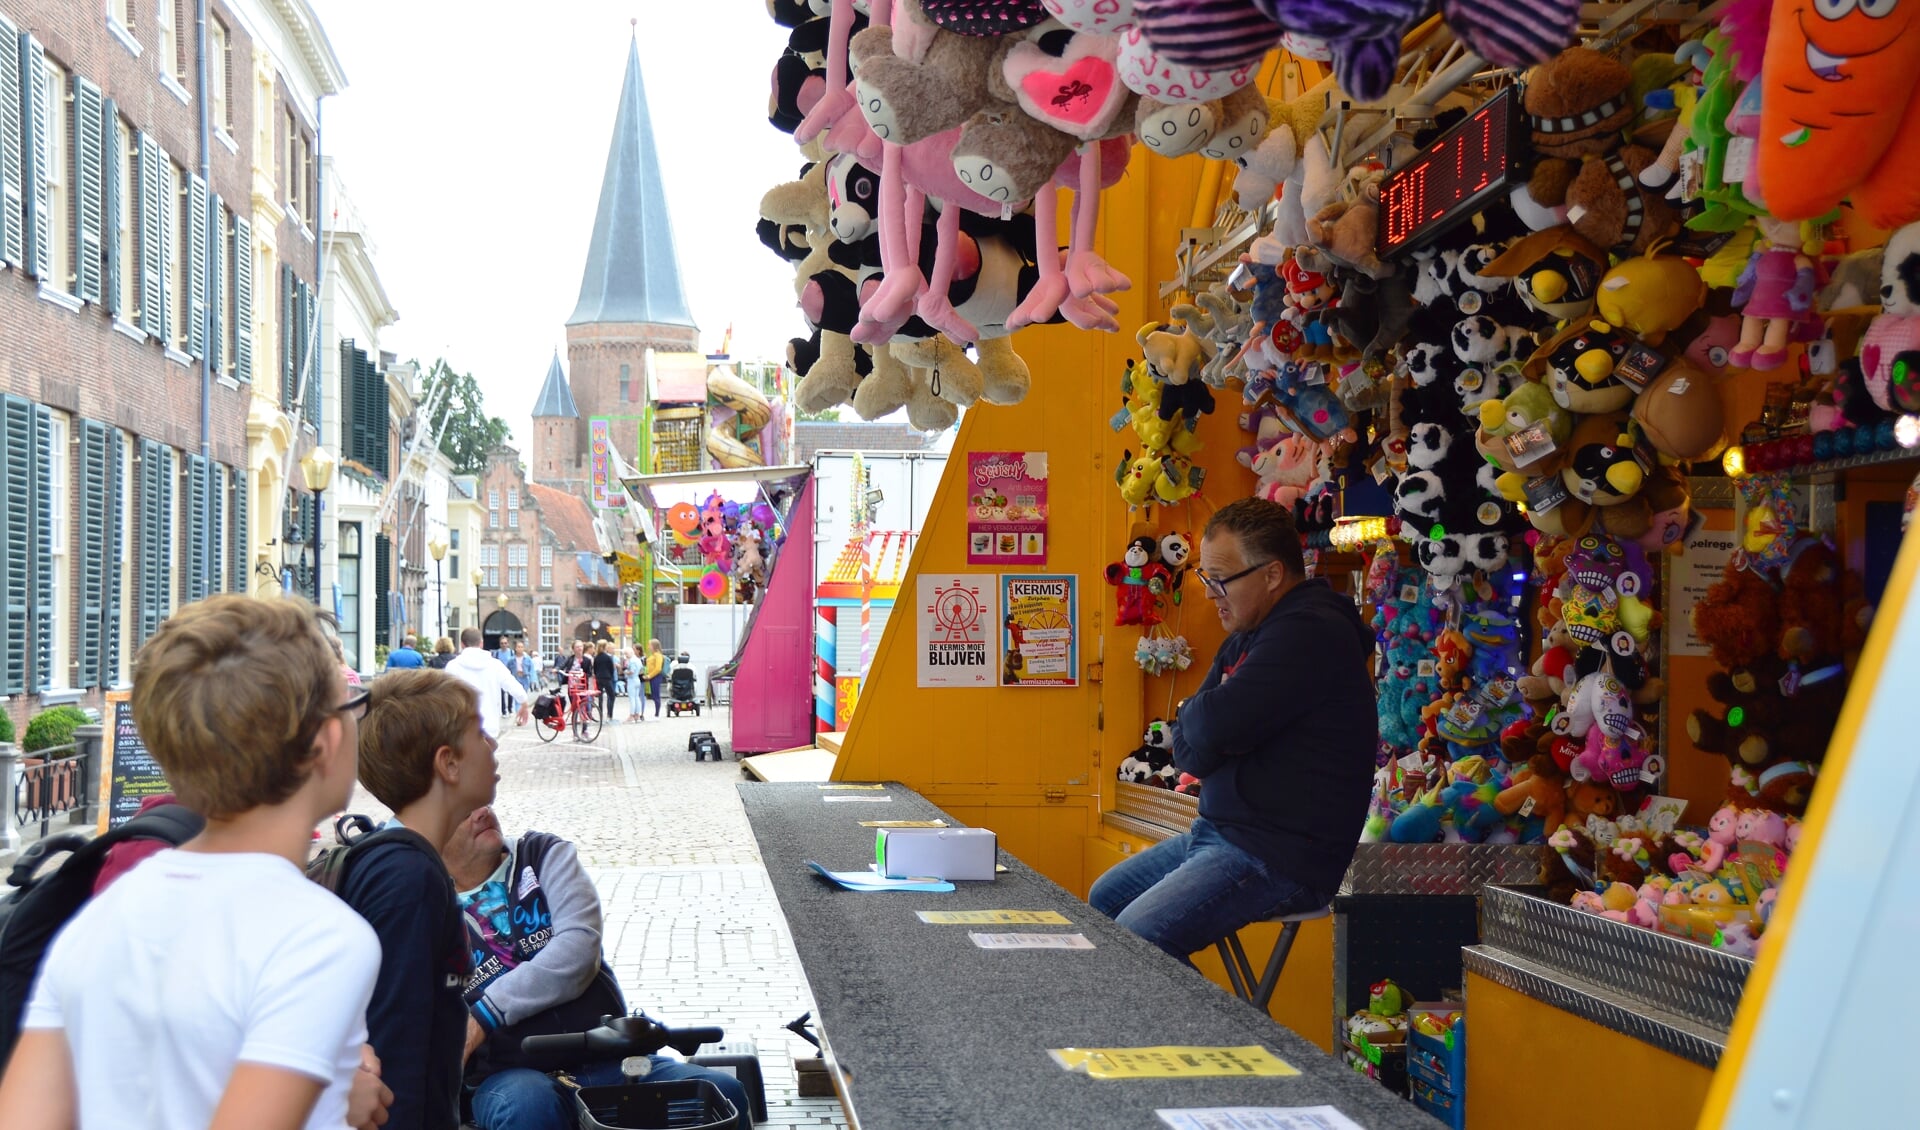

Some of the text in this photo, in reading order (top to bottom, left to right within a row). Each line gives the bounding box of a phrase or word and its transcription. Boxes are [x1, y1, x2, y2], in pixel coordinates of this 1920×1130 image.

[592, 426, 607, 501] HOTEL
[1014, 583, 1063, 595] KERMIS
[929, 643, 985, 651] DE KERMIS MOET
[929, 651, 986, 666] BLIJVEN
[463, 972, 491, 994] WARRIOR
